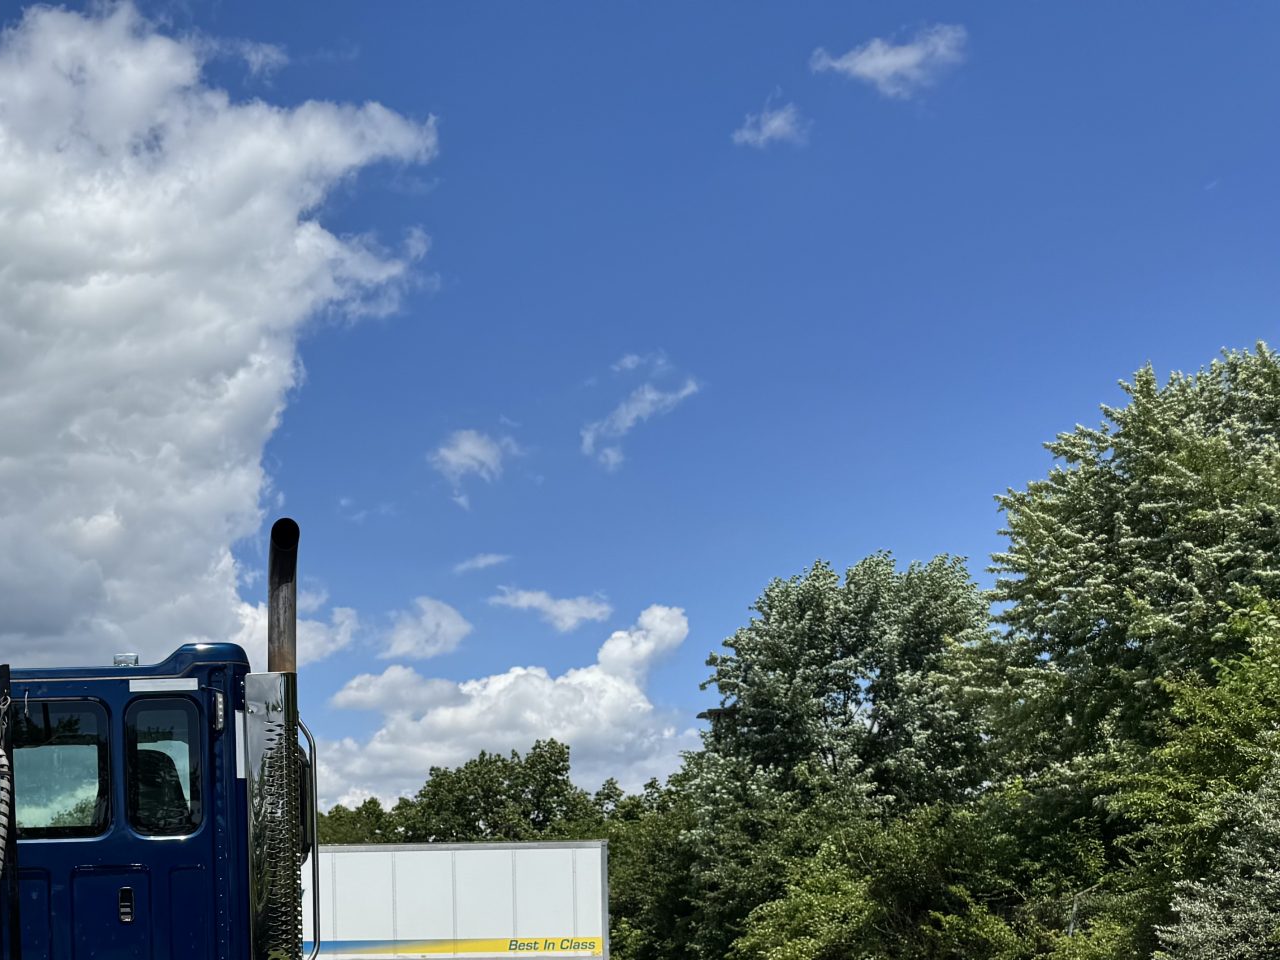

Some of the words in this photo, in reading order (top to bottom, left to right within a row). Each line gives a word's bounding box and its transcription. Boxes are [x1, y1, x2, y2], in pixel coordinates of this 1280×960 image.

[508, 940, 539, 951] Best
[543, 939, 555, 951] In
[560, 939, 596, 950] Class
